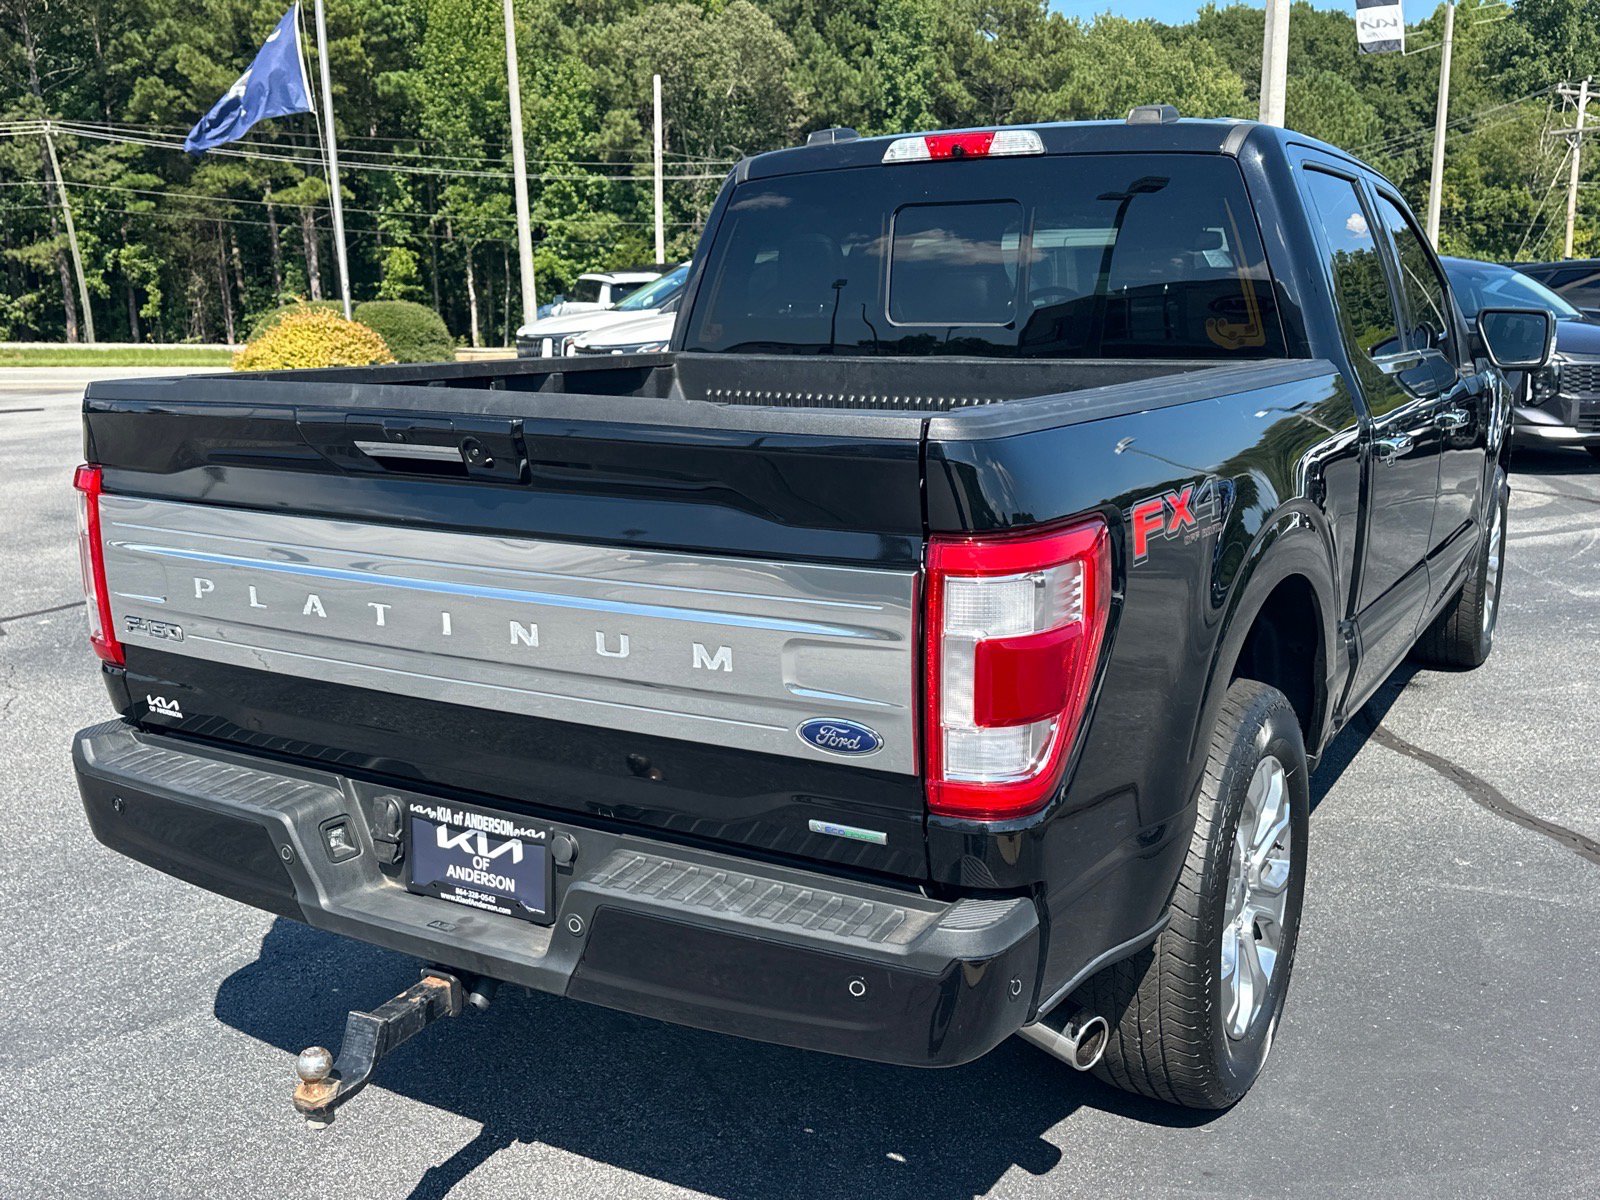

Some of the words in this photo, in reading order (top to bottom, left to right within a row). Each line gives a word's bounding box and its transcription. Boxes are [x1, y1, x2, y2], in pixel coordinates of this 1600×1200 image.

[1131, 475, 1222, 568] FX4
[124, 615, 185, 643] F-150
[193, 577, 734, 672] PLATINUM
[146, 694, 180, 711] KIA
[815, 725, 861, 750] Ford
[436, 806, 452, 824] KIA
[453, 811, 464, 826] of
[464, 812, 514, 837] ANDERSON
[436, 823, 524, 865] KIA
[472, 856, 491, 871] OF
[446, 864, 516, 893] ANDERSON
